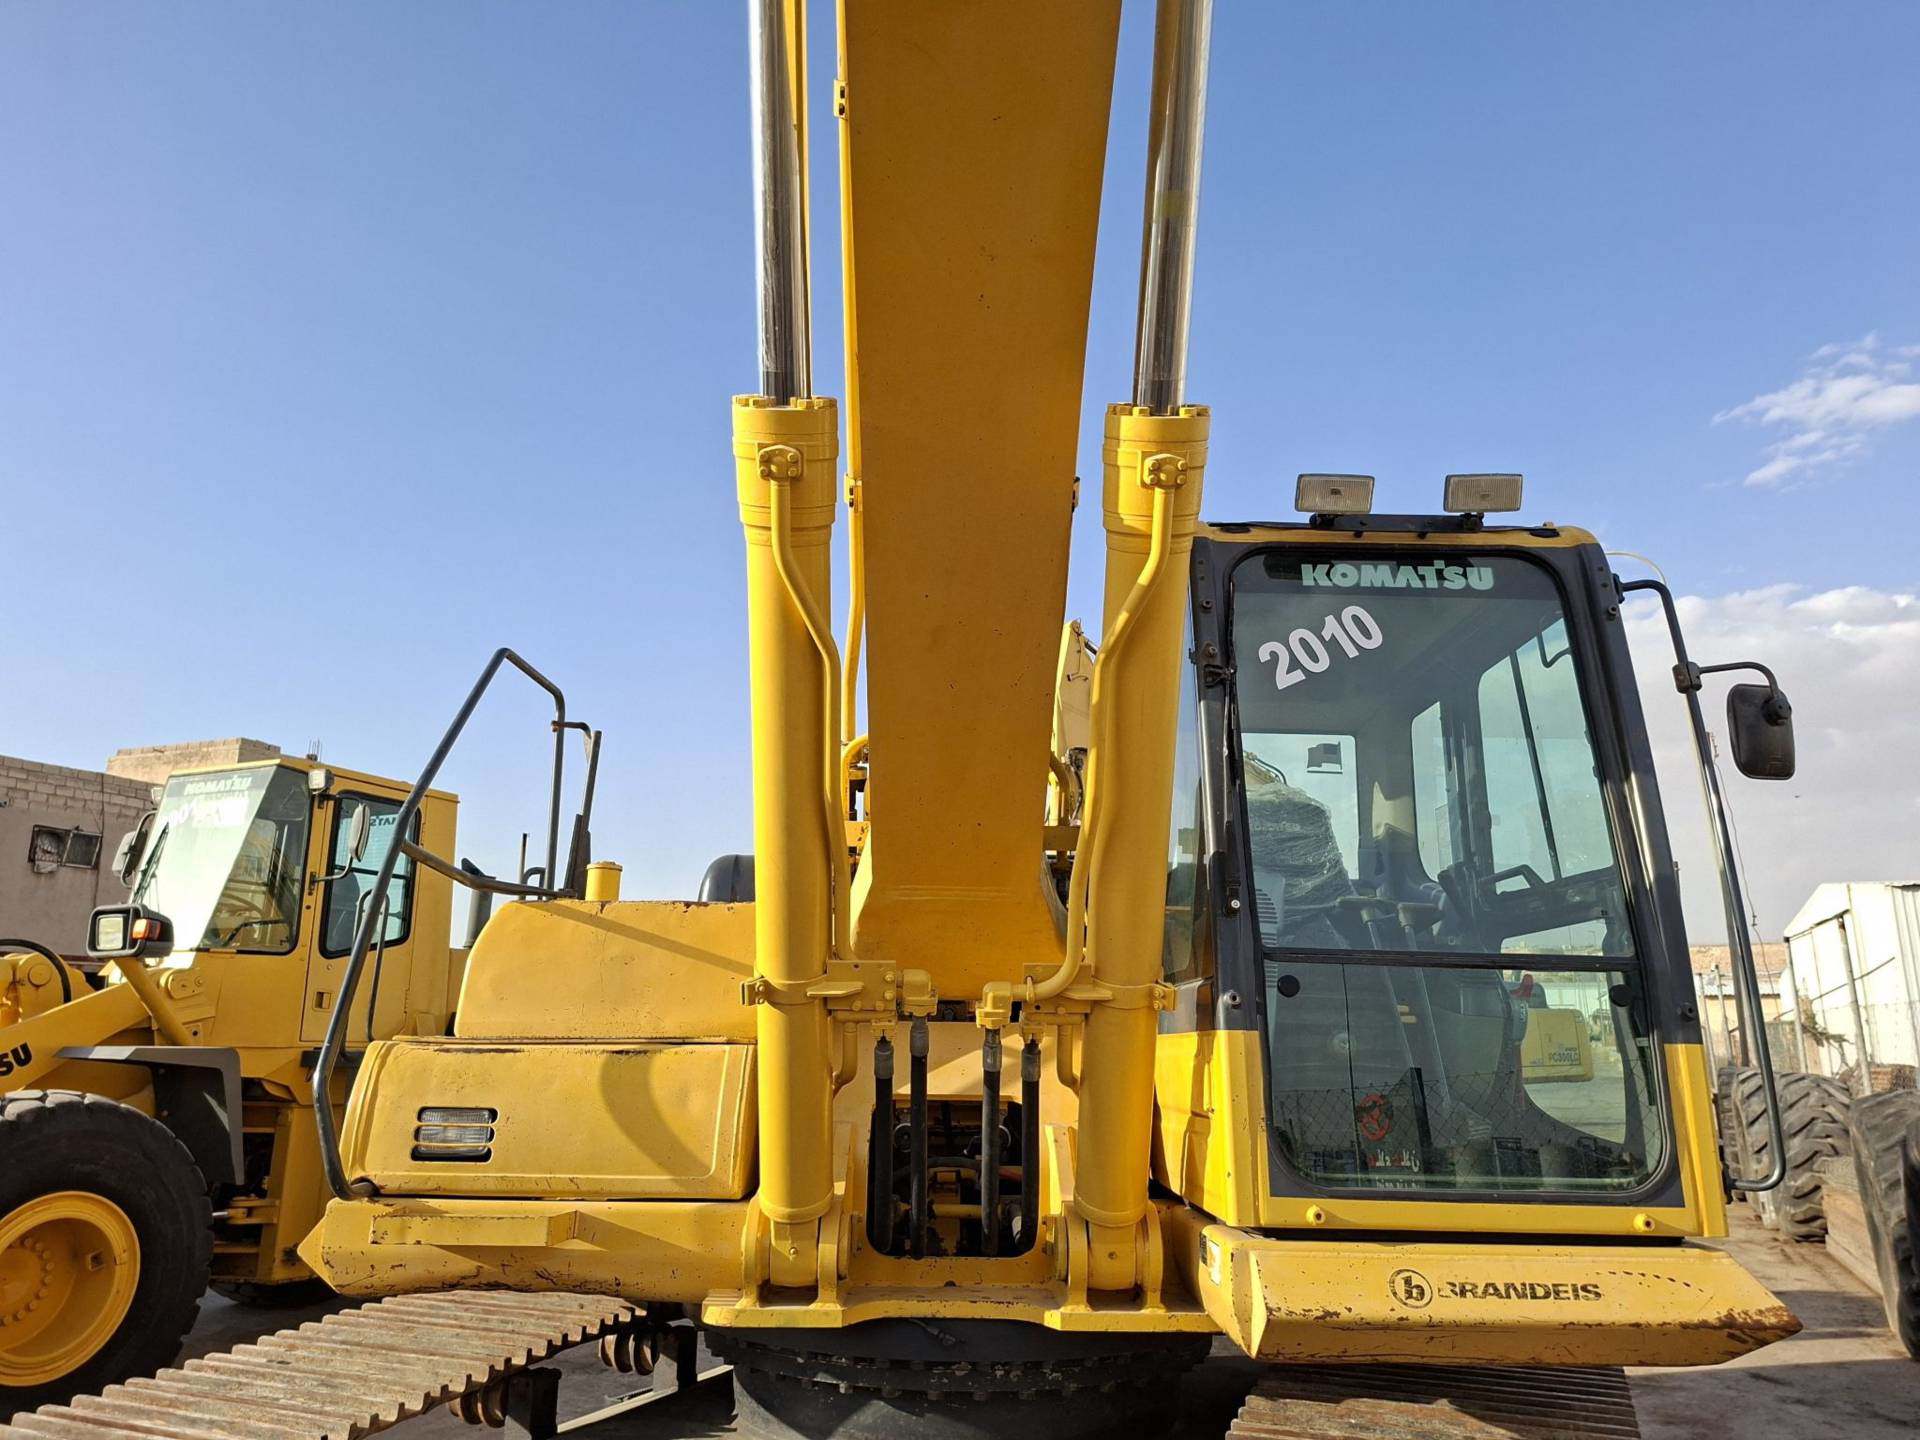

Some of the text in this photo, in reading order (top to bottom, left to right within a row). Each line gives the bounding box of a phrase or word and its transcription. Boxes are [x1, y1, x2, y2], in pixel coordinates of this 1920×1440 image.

[1302, 560, 1494, 590] KOMATSU
[1259, 605, 1383, 690] 2010
[184, 776, 252, 796] KOMATSU
